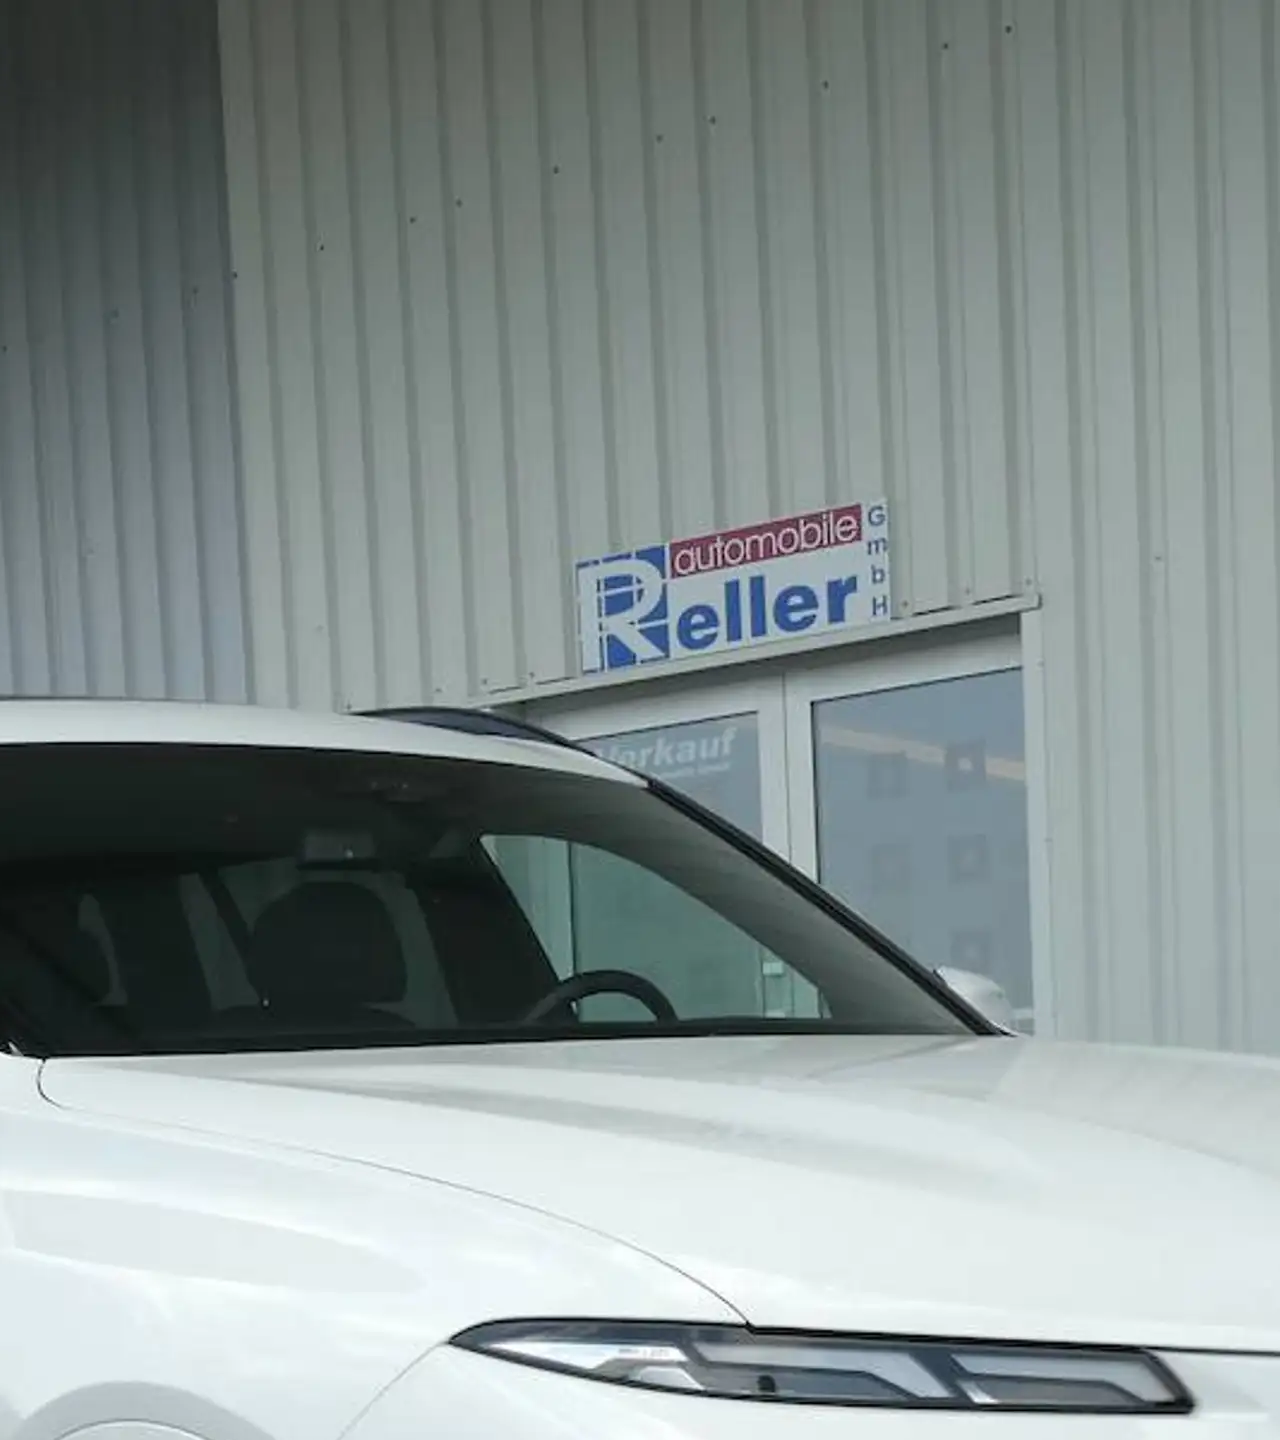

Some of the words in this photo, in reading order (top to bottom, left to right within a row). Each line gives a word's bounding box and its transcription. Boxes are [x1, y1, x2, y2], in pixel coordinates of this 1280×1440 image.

[673, 510, 859, 577] automobile
[866, 504, 889, 618] GmbH
[575, 546, 859, 674] Reller
